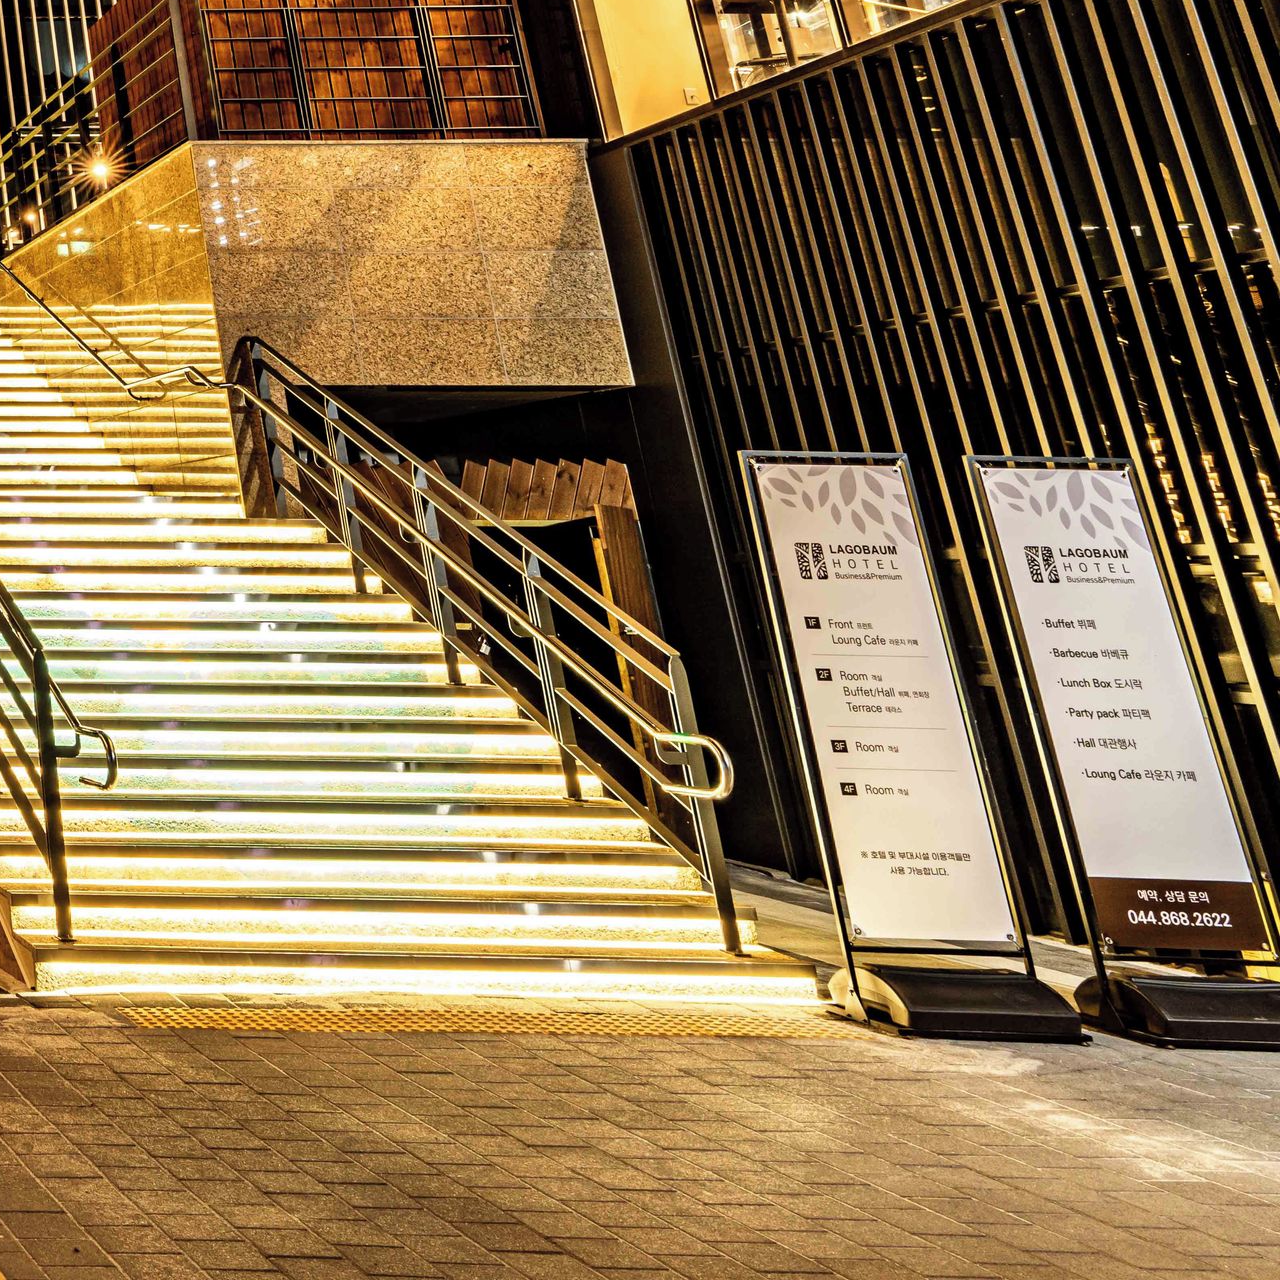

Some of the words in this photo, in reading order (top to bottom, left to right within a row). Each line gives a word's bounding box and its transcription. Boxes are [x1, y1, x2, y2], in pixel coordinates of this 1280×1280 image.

[828, 544, 898, 556] LAGOBAUM
[1059, 547, 1129, 559] LAGOBAUM
[832, 558, 899, 570] HOTEL
[1062, 562, 1131, 574] HOTEL
[834, 572, 903, 581] Business&Premium
[1066, 575, 1136, 585] Business&Premium
[828, 618, 854, 629] Front
[1044, 618, 1076, 629] Buffet
[1077, 619, 1097, 630] 뷔페
[831, 634, 862, 647] Loung
[863, 635, 887, 646] Cafe
[1052, 648, 1099, 659] Barbecue
[1100, 648, 1130, 660] 바베큐
[839, 670, 869, 681] Room
[1060, 677, 1091, 689] Lunch
[1092, 678, 1113, 689] Box
[1114, 678, 1143, 690] 도시락
[842, 686, 896, 698] Buffet/Hall
[845, 701, 883, 713] Terrace
[1068, 707, 1094, 720] Party
[1096, 708, 1120, 721] pack
[1121, 708, 1152, 721] 파티팩
[855, 741, 885, 752] Room
[1076, 737, 1096, 748] Hall
[1097, 738, 1138, 750] 대관행사
[1084, 768, 1117, 781] Loung
[1118, 768, 1142, 780] Cafe
[1143, 769, 1175, 781] 라운지
[1176, 770, 1198, 782] 카페
[864, 783, 895, 795] Room
[870, 850, 887, 860] 호텔
[888, 851, 897, 860] 및
[898, 851, 930, 861] 부대시설
[931, 852, 972, 862] 이용객들만
[890, 866, 906, 875] 사용
[907, 866, 950, 877] 가능합니다.
[1164, 890, 1186, 903] 상담
[1188, 890, 1211, 904] 문의
[1127, 909, 1233, 928] 044.868.2622
